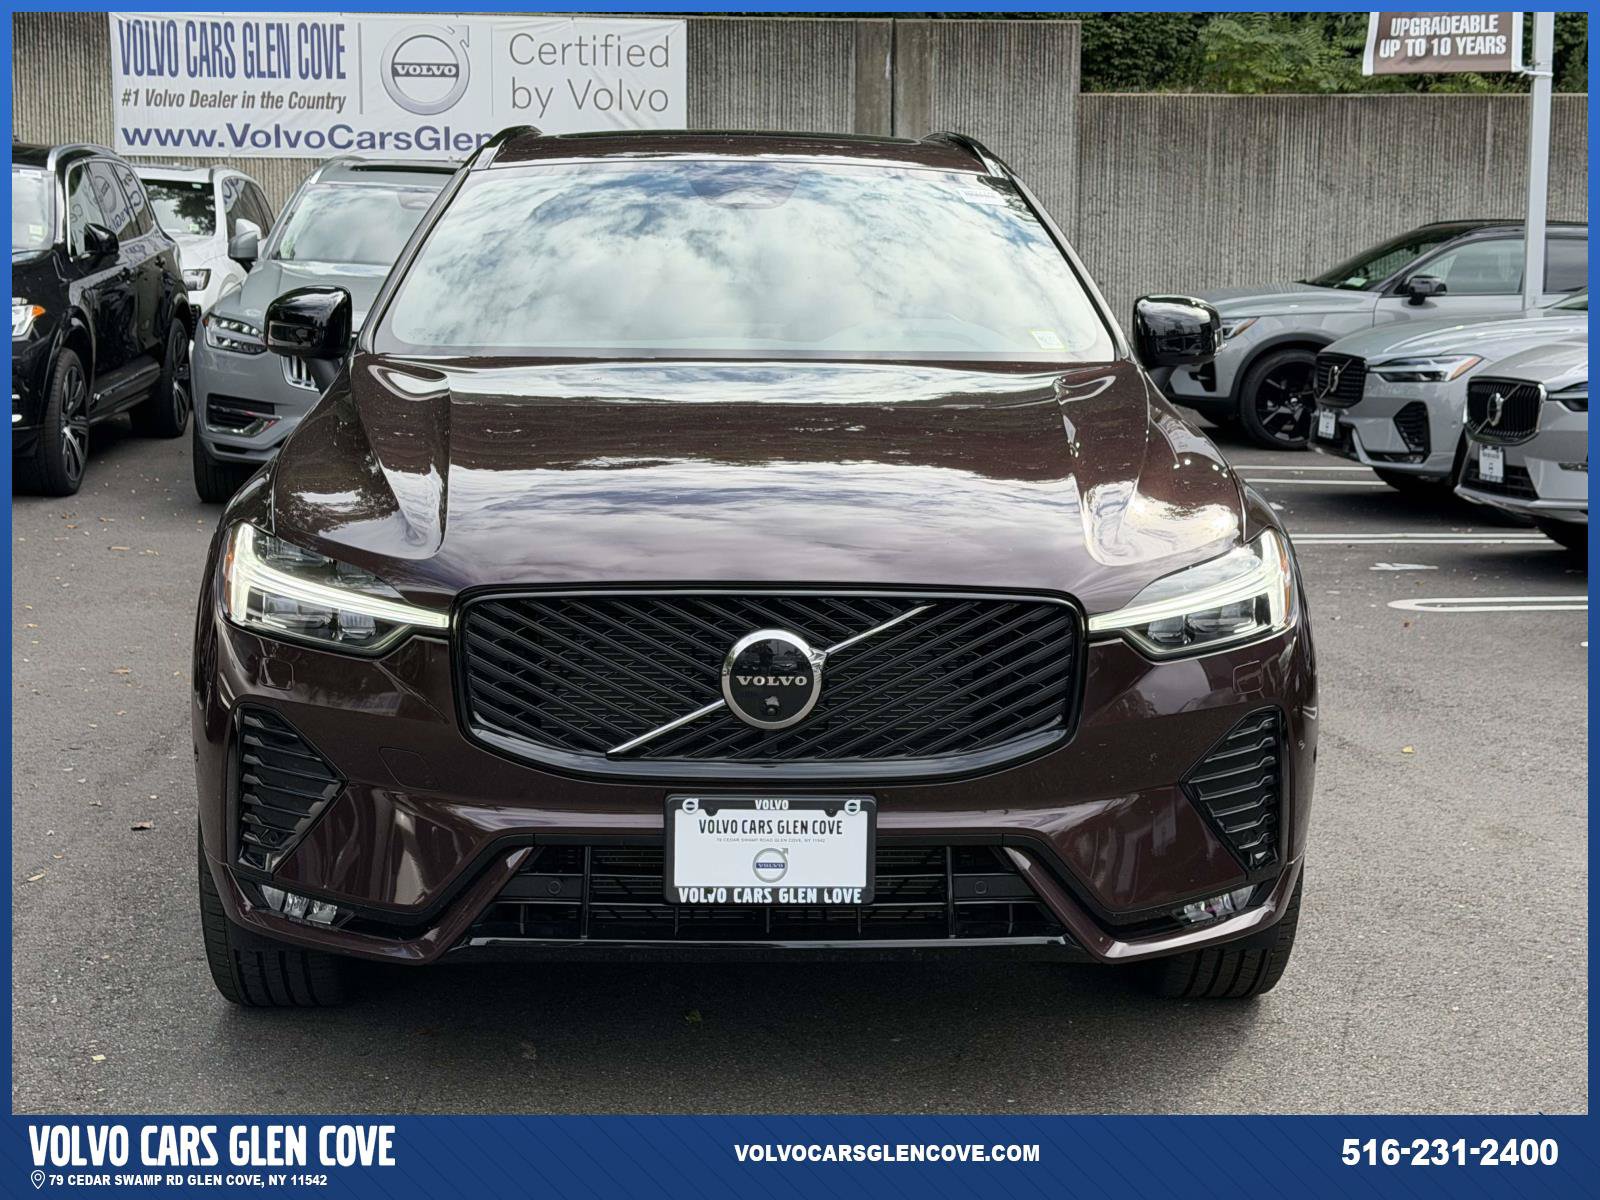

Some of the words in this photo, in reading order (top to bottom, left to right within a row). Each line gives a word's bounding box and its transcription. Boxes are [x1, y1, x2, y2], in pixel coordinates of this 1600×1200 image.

[1391, 14, 1499, 36] UPGRADEABLE
[118, 20, 179, 78] VOLVO
[185, 20, 236, 79] CARS
[242, 22, 291, 79] GLEN
[297, 22, 346, 80] COVE
[509, 33, 669, 68] Certified
[1379, 39, 1400, 58] UP
[1405, 37, 1426, 56] TO
[1431, 37, 1450, 56] 10
[1456, 35, 1507, 55] YEARS
[393, 64, 457, 76] VOLVO
[121, 88, 140, 107] #1
[145, 89, 185, 108] Volvo
[190, 91, 238, 109] Dealer
[241, 91, 255, 109] in
[260, 92, 283, 109] the
[288, 91, 346, 114] Country
[512, 77, 553, 119] by
[567, 78, 669, 112] Volvo
[736, 675, 807, 686] VOLVO
[754, 799, 789, 810] VOLVO
[699, 819, 738, 835] VOLVO
[741, 819, 773, 835] CARS
[777, 819, 808, 835] GLEN
[812, 820, 843, 835] COVE
[678, 887, 727, 904] VOLVO
[733, 887, 772, 904] CARS
[778, 887, 817, 904] GLEN
